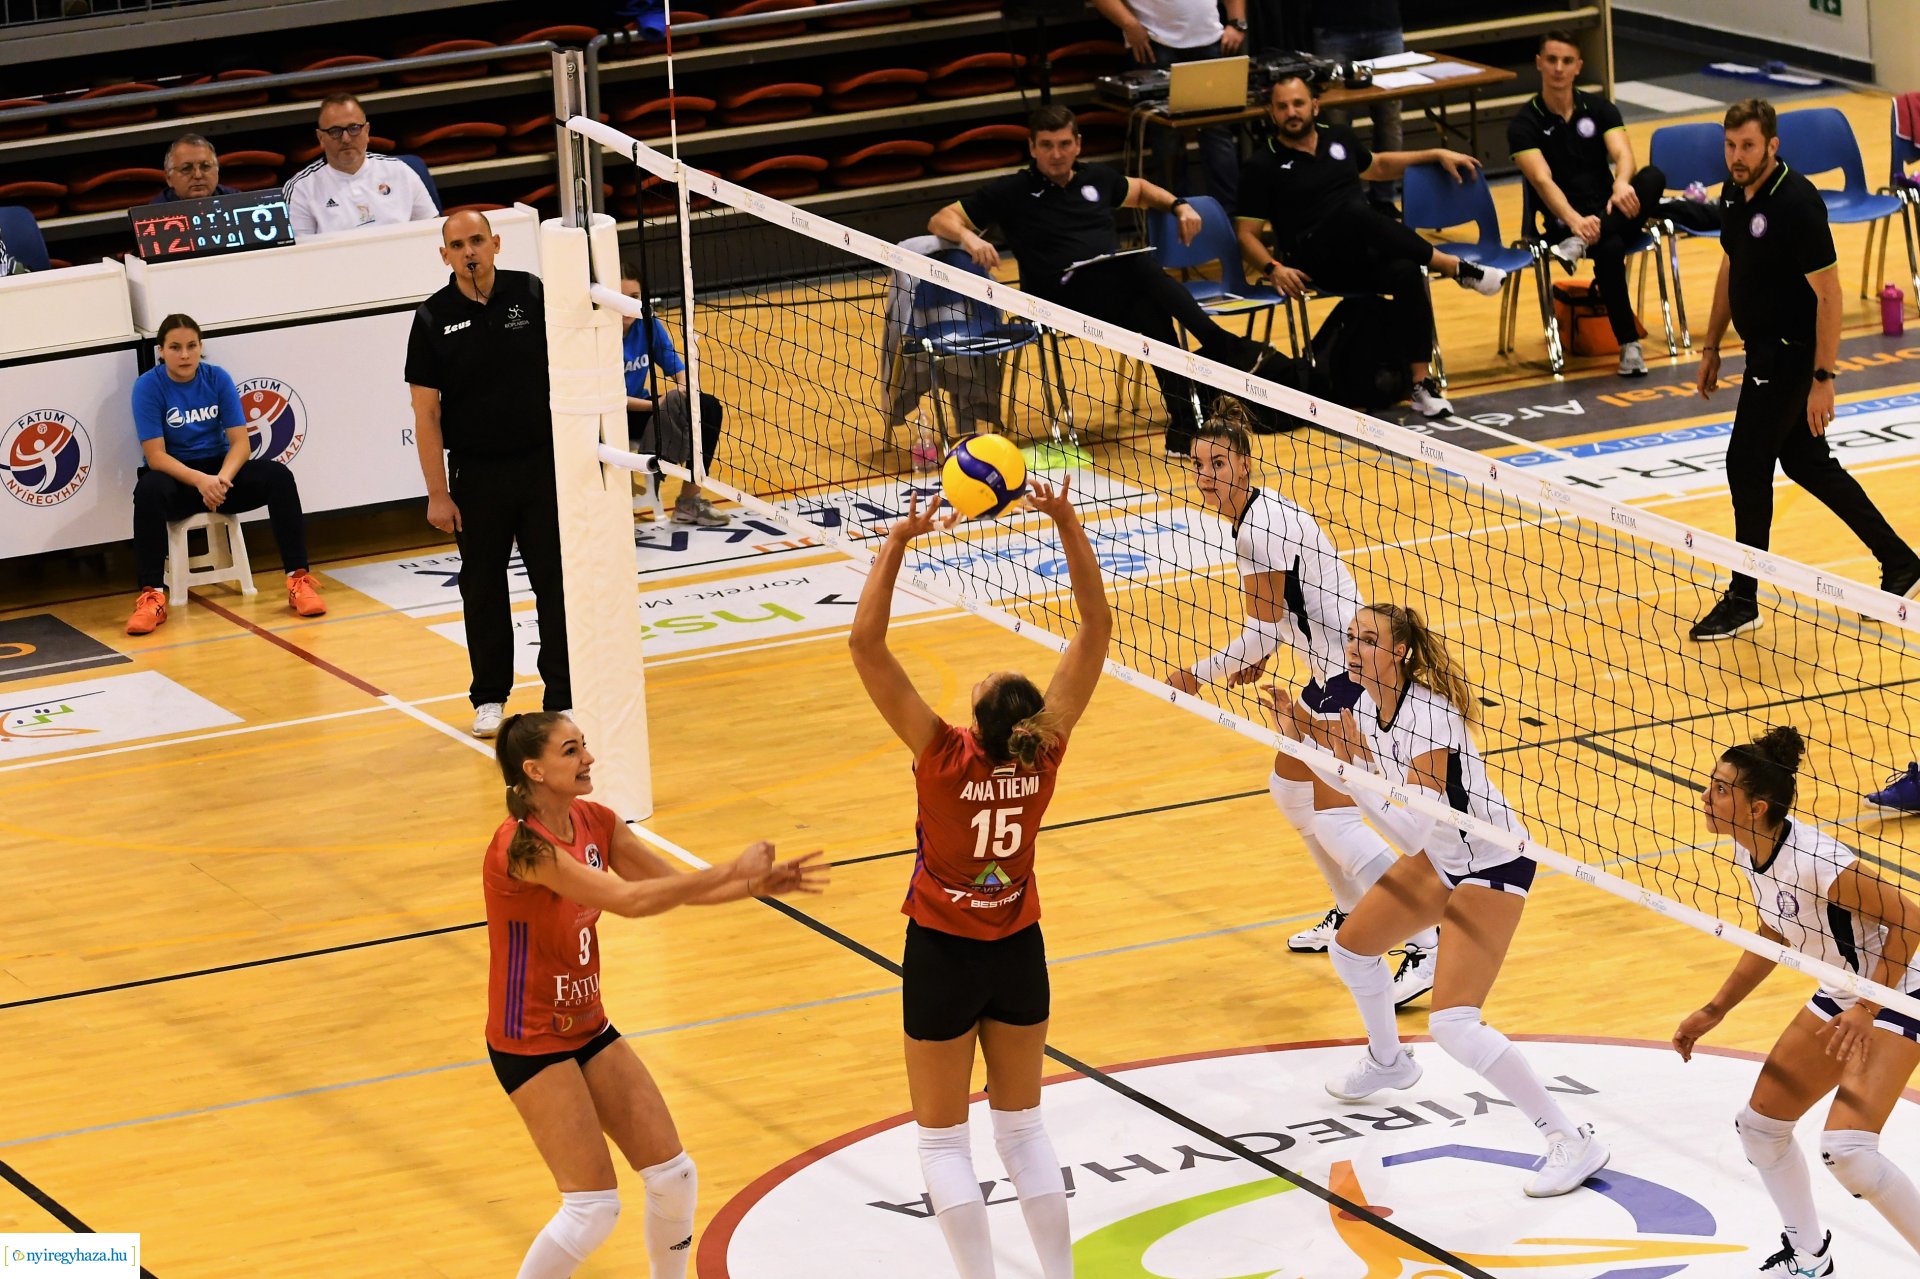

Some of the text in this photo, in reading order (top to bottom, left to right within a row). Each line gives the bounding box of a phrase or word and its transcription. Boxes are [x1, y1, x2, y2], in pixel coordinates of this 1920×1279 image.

[444, 320, 471, 335] Zeus
[624, 353, 649, 373] AKO
[1245, 378, 1269, 400] FATUM
[18, 411, 65, 430] FATUM
[185, 404, 219, 424] JAKO
[1420, 440, 1445, 463] FATUM
[1611, 506, 1637, 529] FATUM
[686, 576, 812, 600] Korrekt.
[1816, 576, 1845, 600] FATUM
[960, 775, 1040, 801] ANA TIEMI
[970, 806, 1023, 858] 15
[553, 972, 599, 1001] FATU
